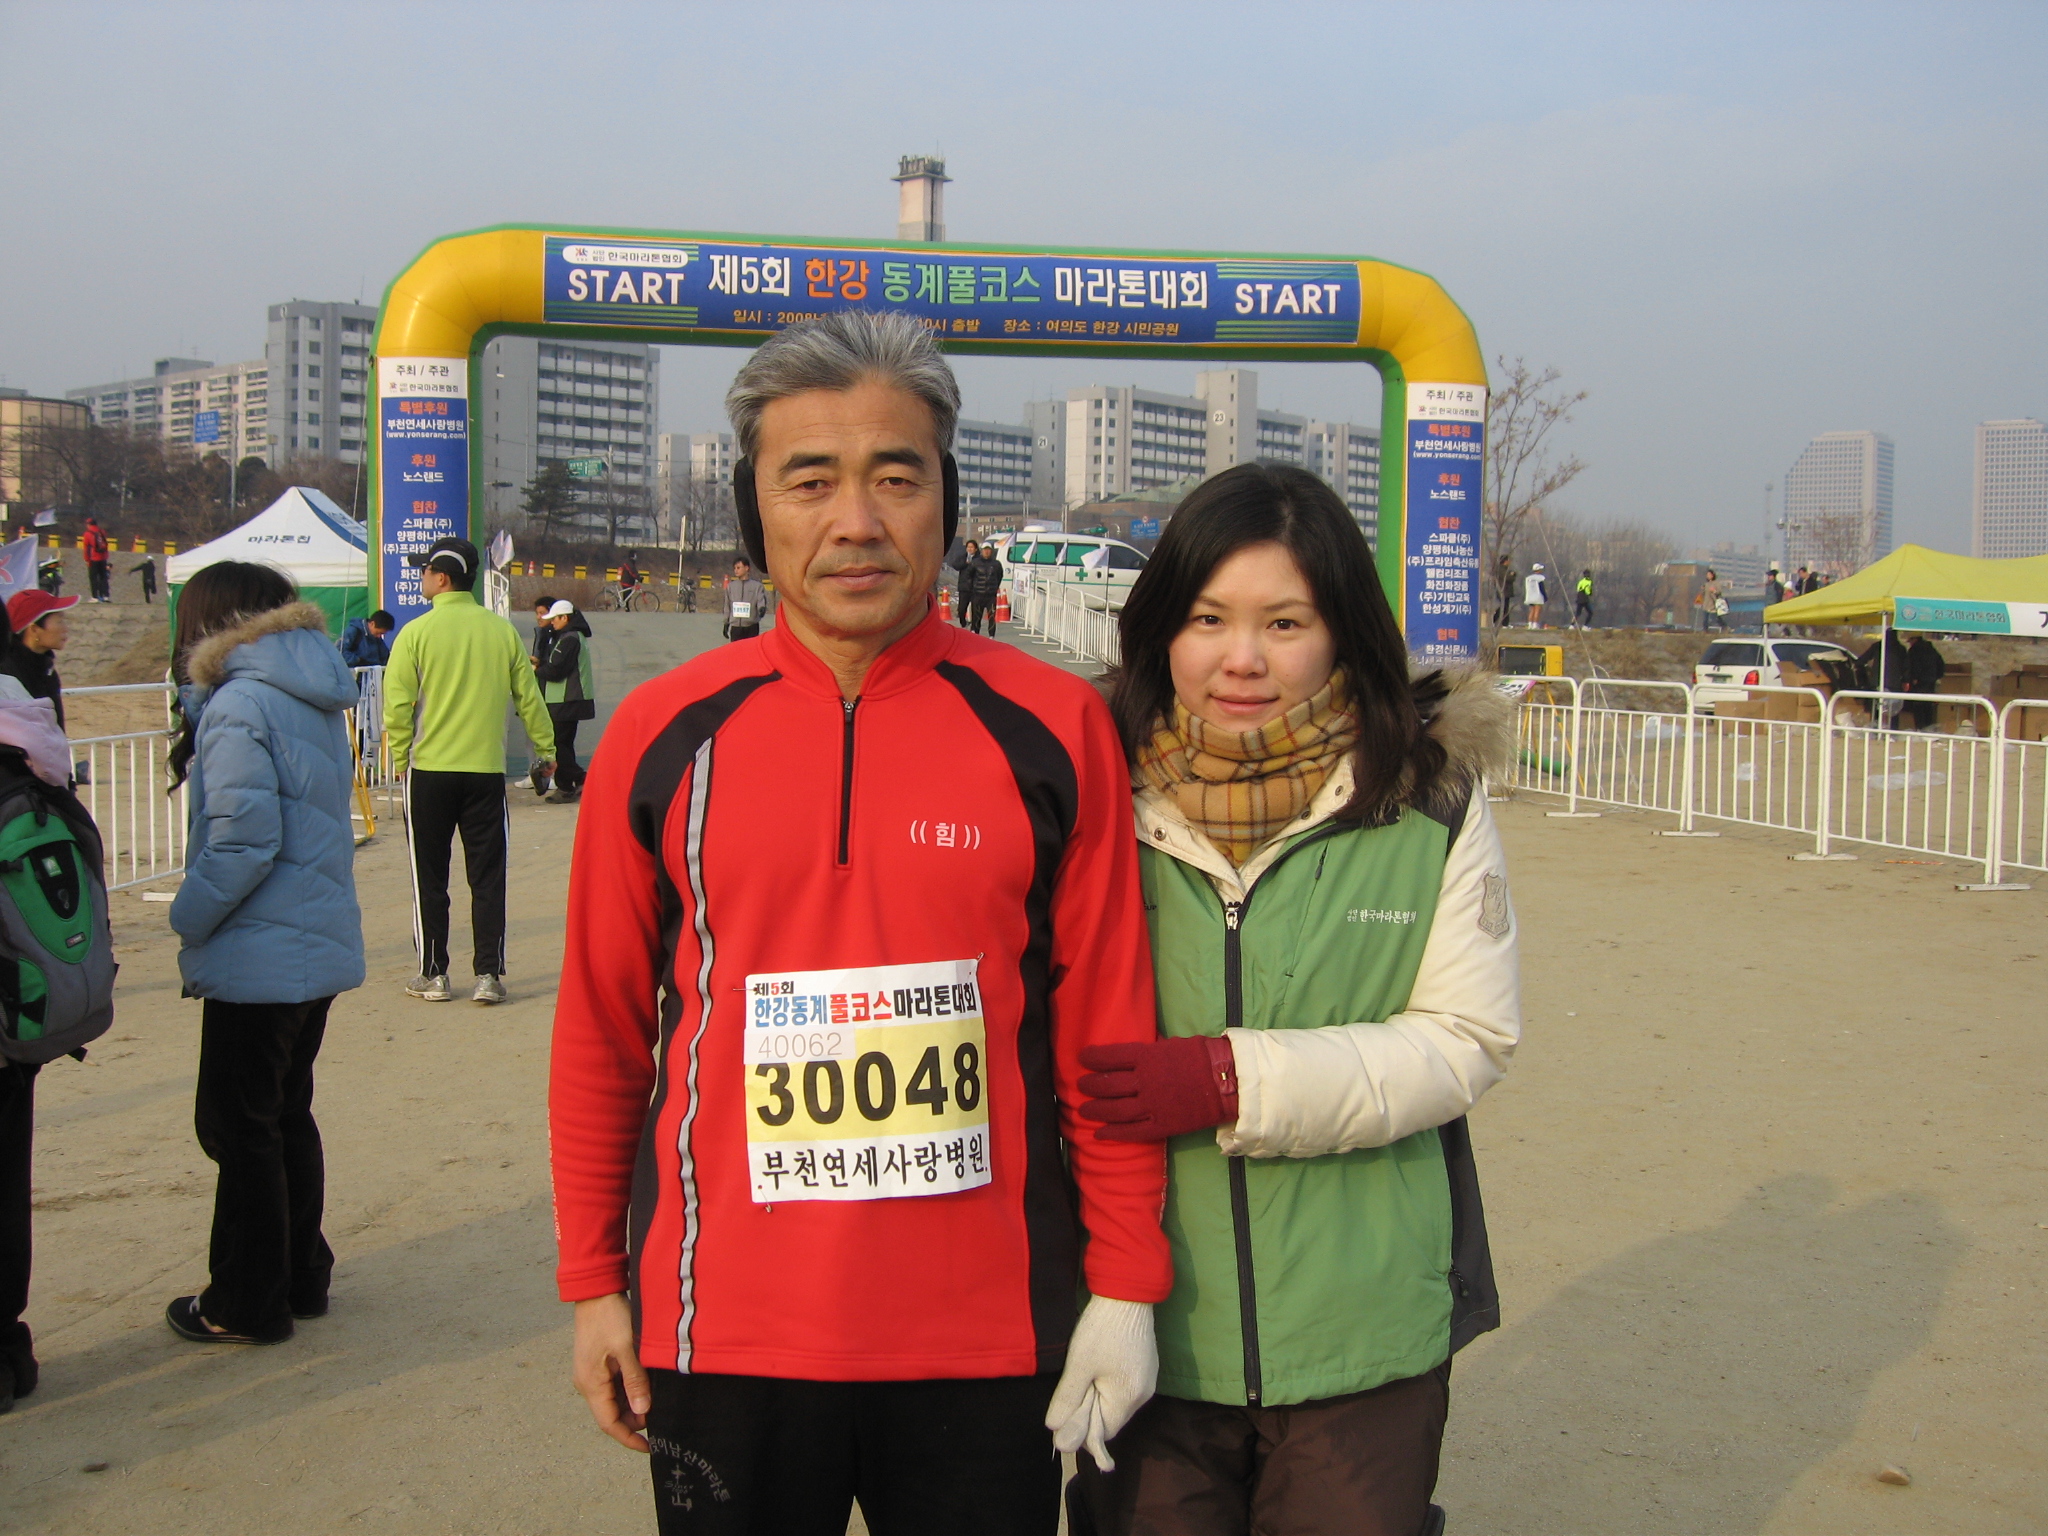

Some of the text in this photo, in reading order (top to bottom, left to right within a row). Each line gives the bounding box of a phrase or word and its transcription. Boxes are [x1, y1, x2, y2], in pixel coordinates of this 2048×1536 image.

[608, 251, 682, 264] 한국마라톤협회
[568, 268, 685, 305] START
[708, 253, 1209, 310] 제5회 한강 동계풀코스 마라톤대회
[1235, 283, 1341, 315] START
[733, 309, 762, 324] 일시
[951, 318, 981, 332] 출발
[1003, 319, 1031, 333] 장소
[1046, 320, 1087, 335] 여의도
[1093, 320, 1121, 335] 한강
[1124, 321, 1179, 336] 시민공원
[396, 365, 416, 376] 주최
[428, 365, 450, 377] 주관
[1426, 389, 1445, 401] 주최
[1456, 391, 1474, 402] 주관
[399, 400, 449, 415] 특별후원
[387, 419, 464, 431] 부천연세사랑병원
[1428, 423, 1472, 438] 특별후원
[386, 430, 466, 440] (www.yonserang.com)
[1414, 439, 1482, 453] 부천연세사랑병원
[411, 453, 437, 468] 후원
[402, 471, 444, 483] 노스랜드
[1437, 473, 1460, 486] 후원
[1429, 490, 1467, 501] 노스랜드
[412, 500, 437, 514] 협찬
[402, 518, 452, 529] 스파클(주)
[1437, 517, 1460, 529] 협찬
[248, 535, 312, 544] 마라톤칩
[1428, 533, 1471, 544] 스파클(주)
[1422, 544, 1474, 556] 양평하나농산
[1425, 580, 1469, 591] 화진화장품
[1419, 591, 1470, 603] (주)기탄교육
[1422, 604, 1472, 615] 한성계기(주)
[1359, 909, 1417, 924] 한국마라톤협회
[753, 980, 795, 996] 제5회
[758, 1032, 843, 1059] 40062
[755, 1042, 981, 1127] 30048
[762, 1133, 985, 1191] 부천연세사랑병원
